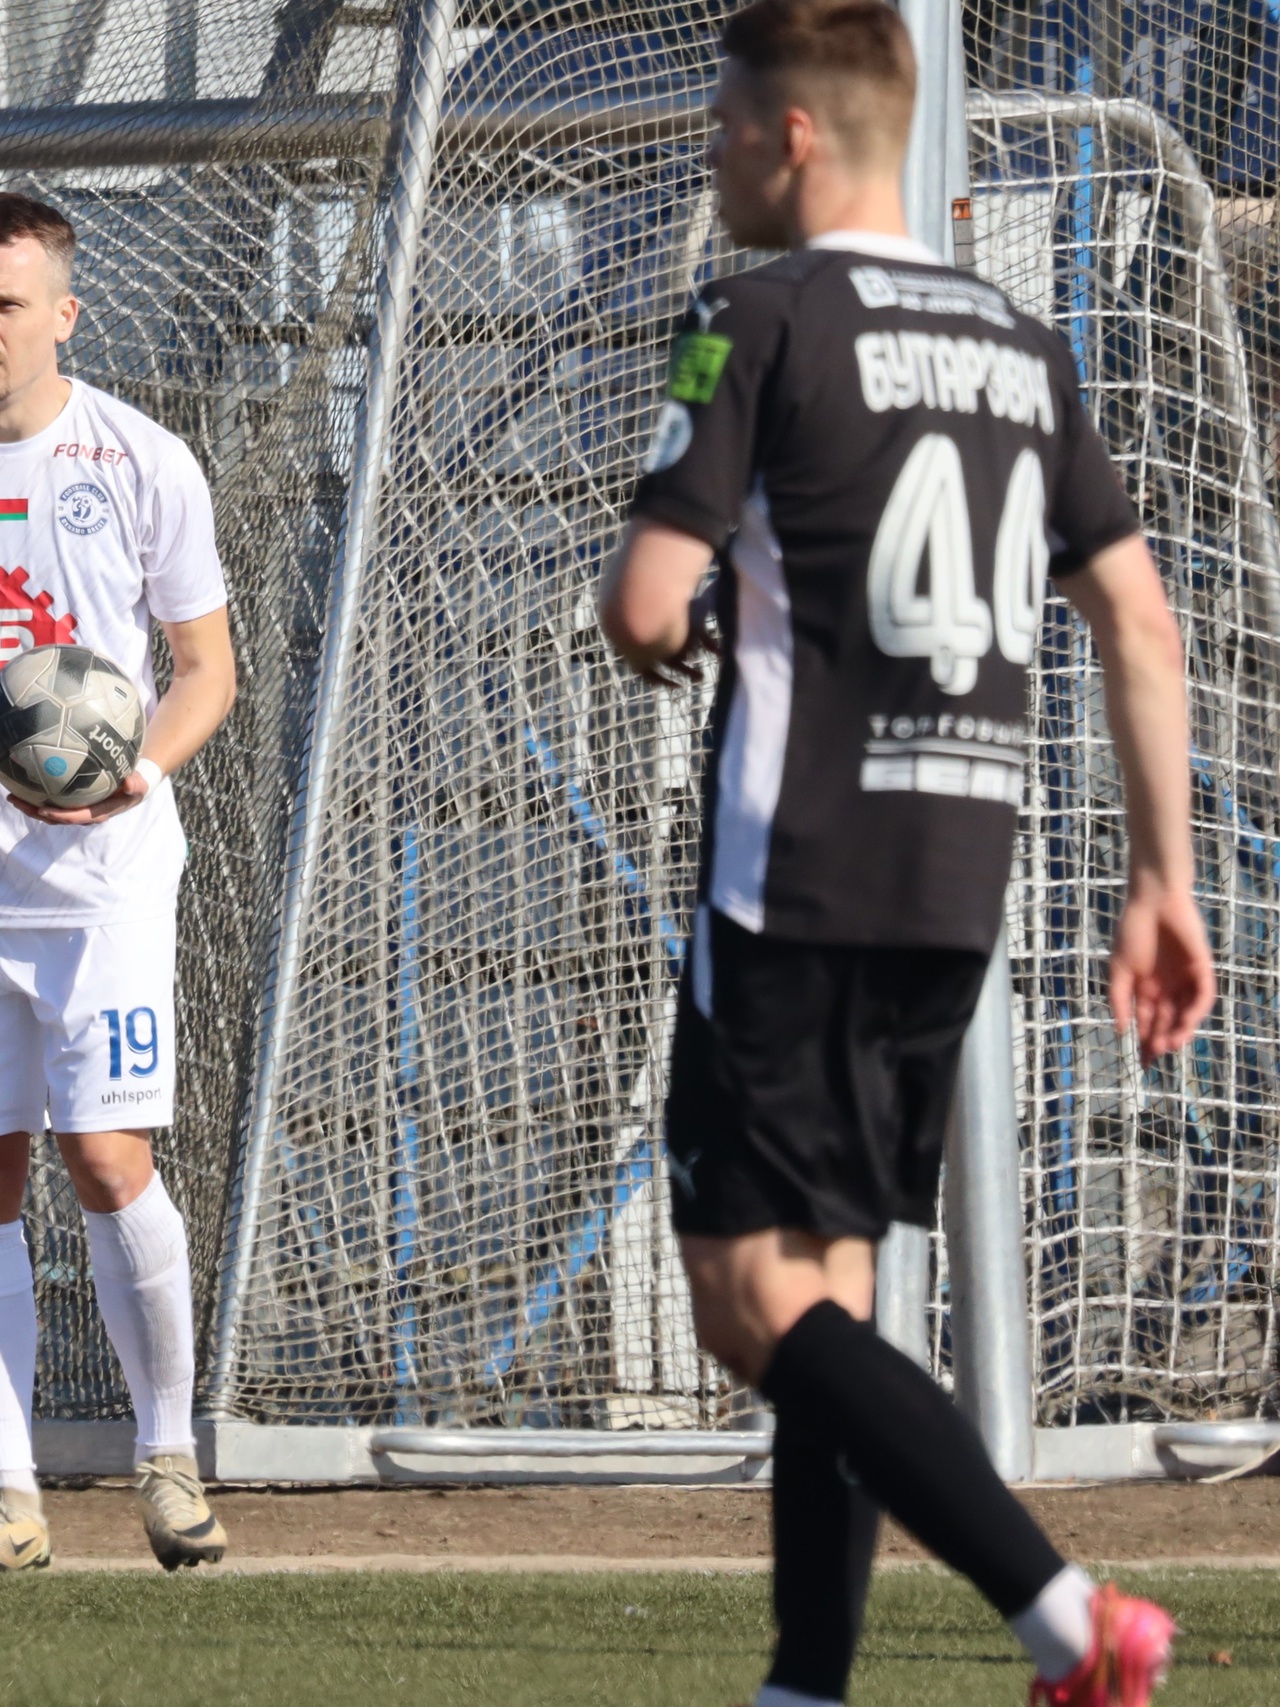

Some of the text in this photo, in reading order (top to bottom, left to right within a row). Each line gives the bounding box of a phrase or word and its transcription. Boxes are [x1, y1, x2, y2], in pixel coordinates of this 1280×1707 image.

[53, 443, 129, 466] FONBET
[867, 431, 1050, 697] 44
[99, 1005, 160, 1081] 19
[101, 1086, 162, 1105] uhlsport
